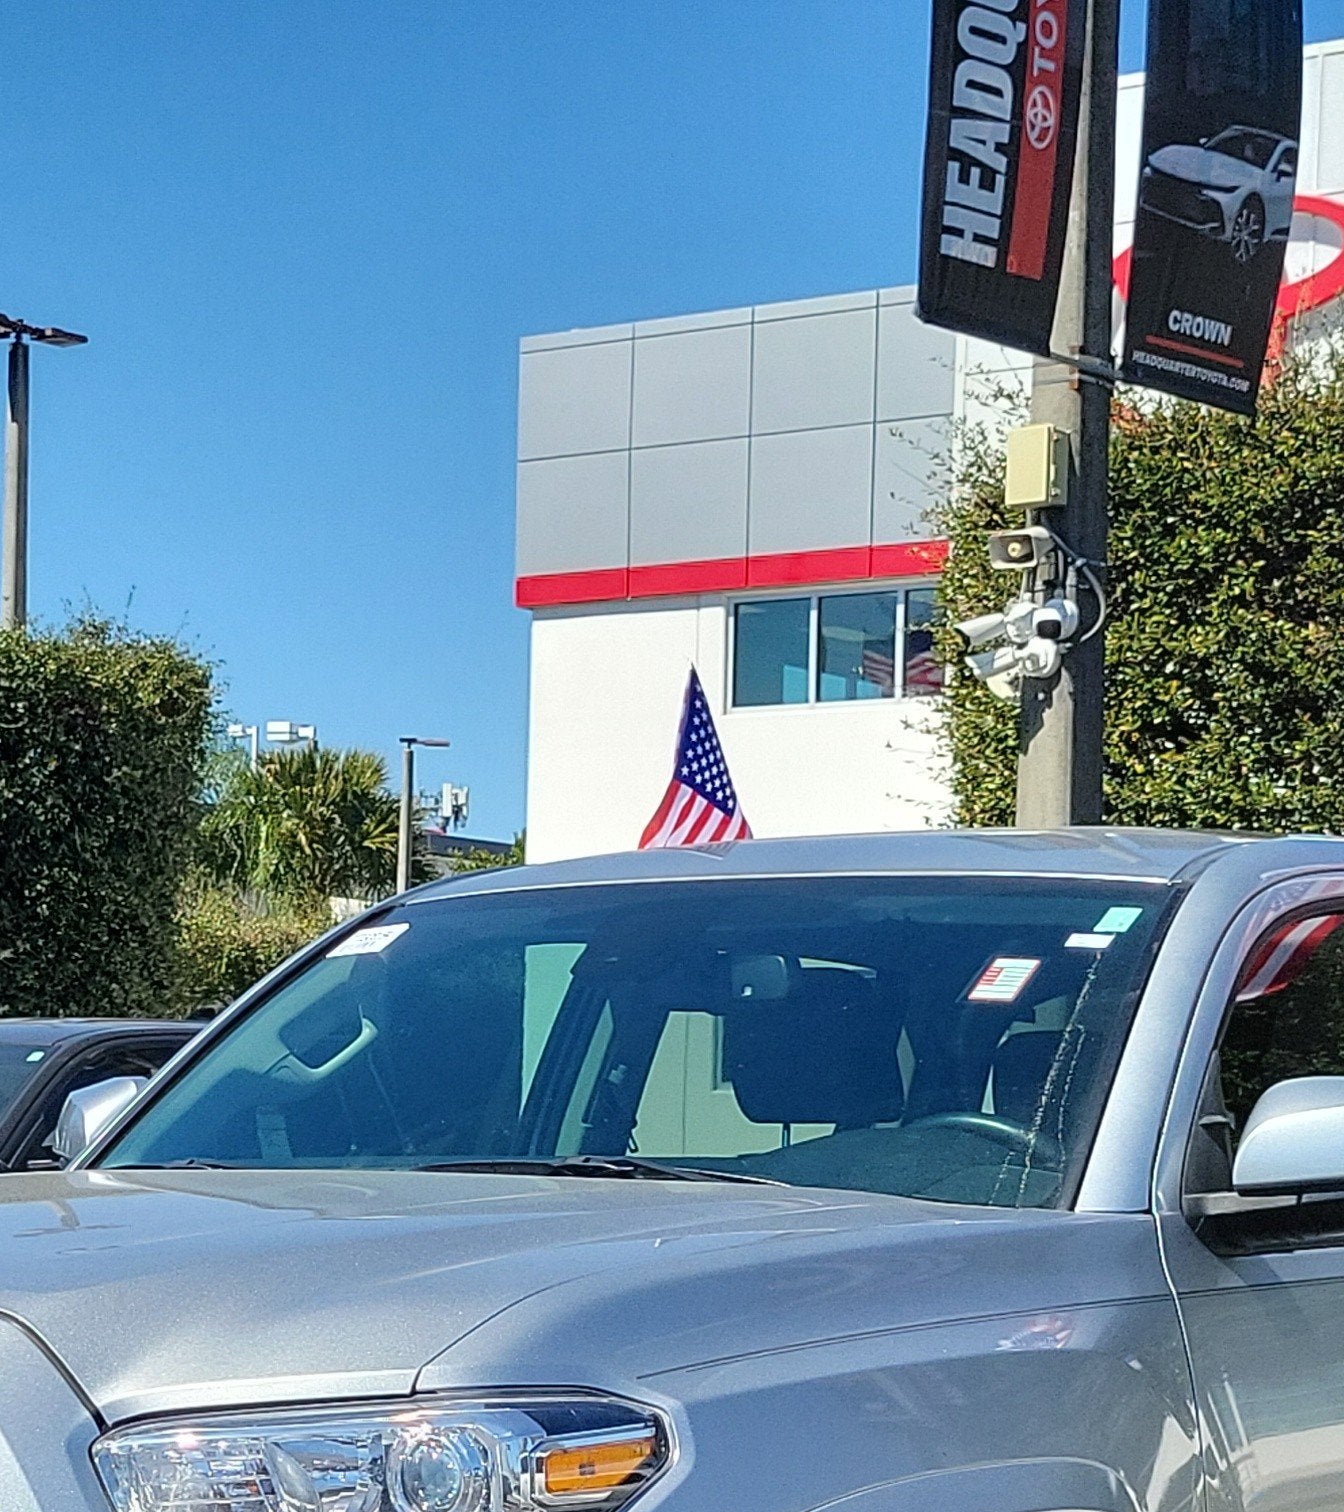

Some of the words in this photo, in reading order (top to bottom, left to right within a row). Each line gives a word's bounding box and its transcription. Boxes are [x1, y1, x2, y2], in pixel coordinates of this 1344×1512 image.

[1033, 0, 1059, 77] TO
[940, 0, 1027, 268] HEADQ
[1167, 309, 1233, 347] CROWN
